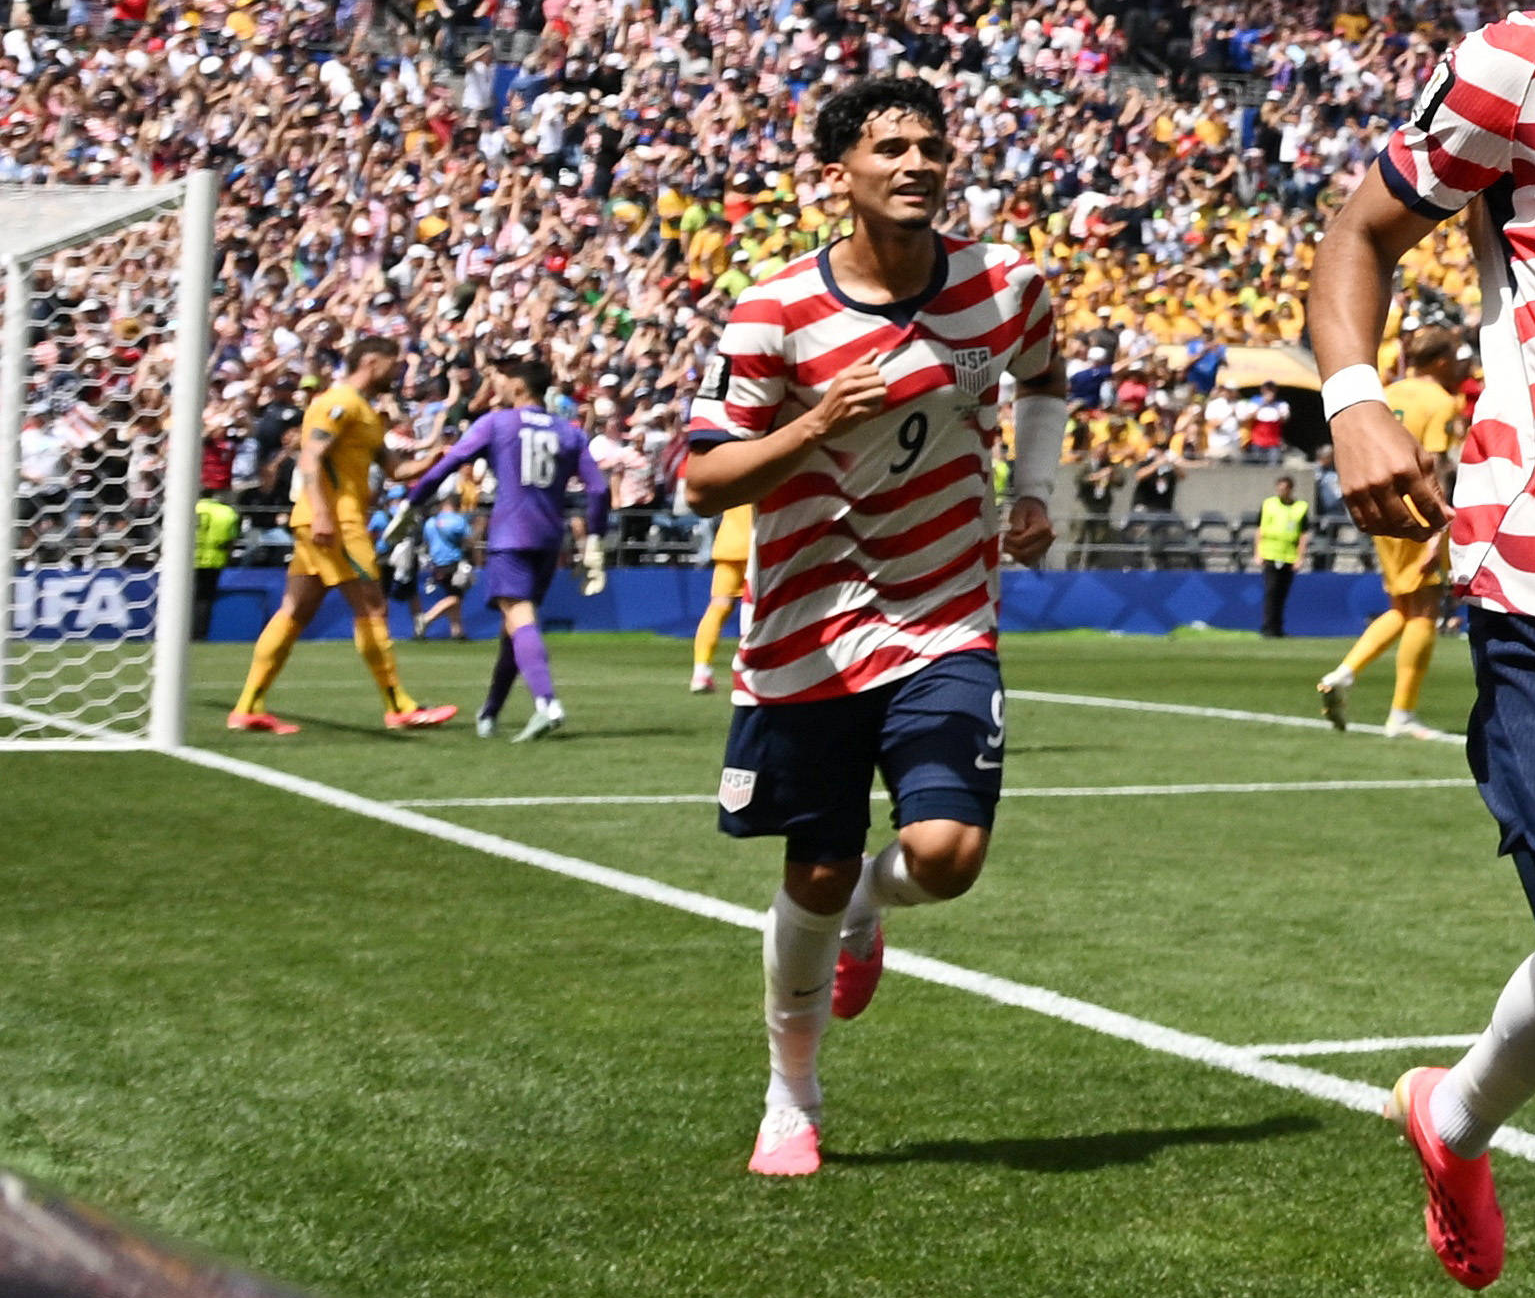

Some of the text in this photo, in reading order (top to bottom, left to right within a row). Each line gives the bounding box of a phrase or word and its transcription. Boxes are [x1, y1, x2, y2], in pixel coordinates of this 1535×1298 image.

[955, 349, 988, 370] USA
[889, 411, 929, 475] 9
[13, 576, 133, 629] IFA
[723, 771, 753, 789] USA
